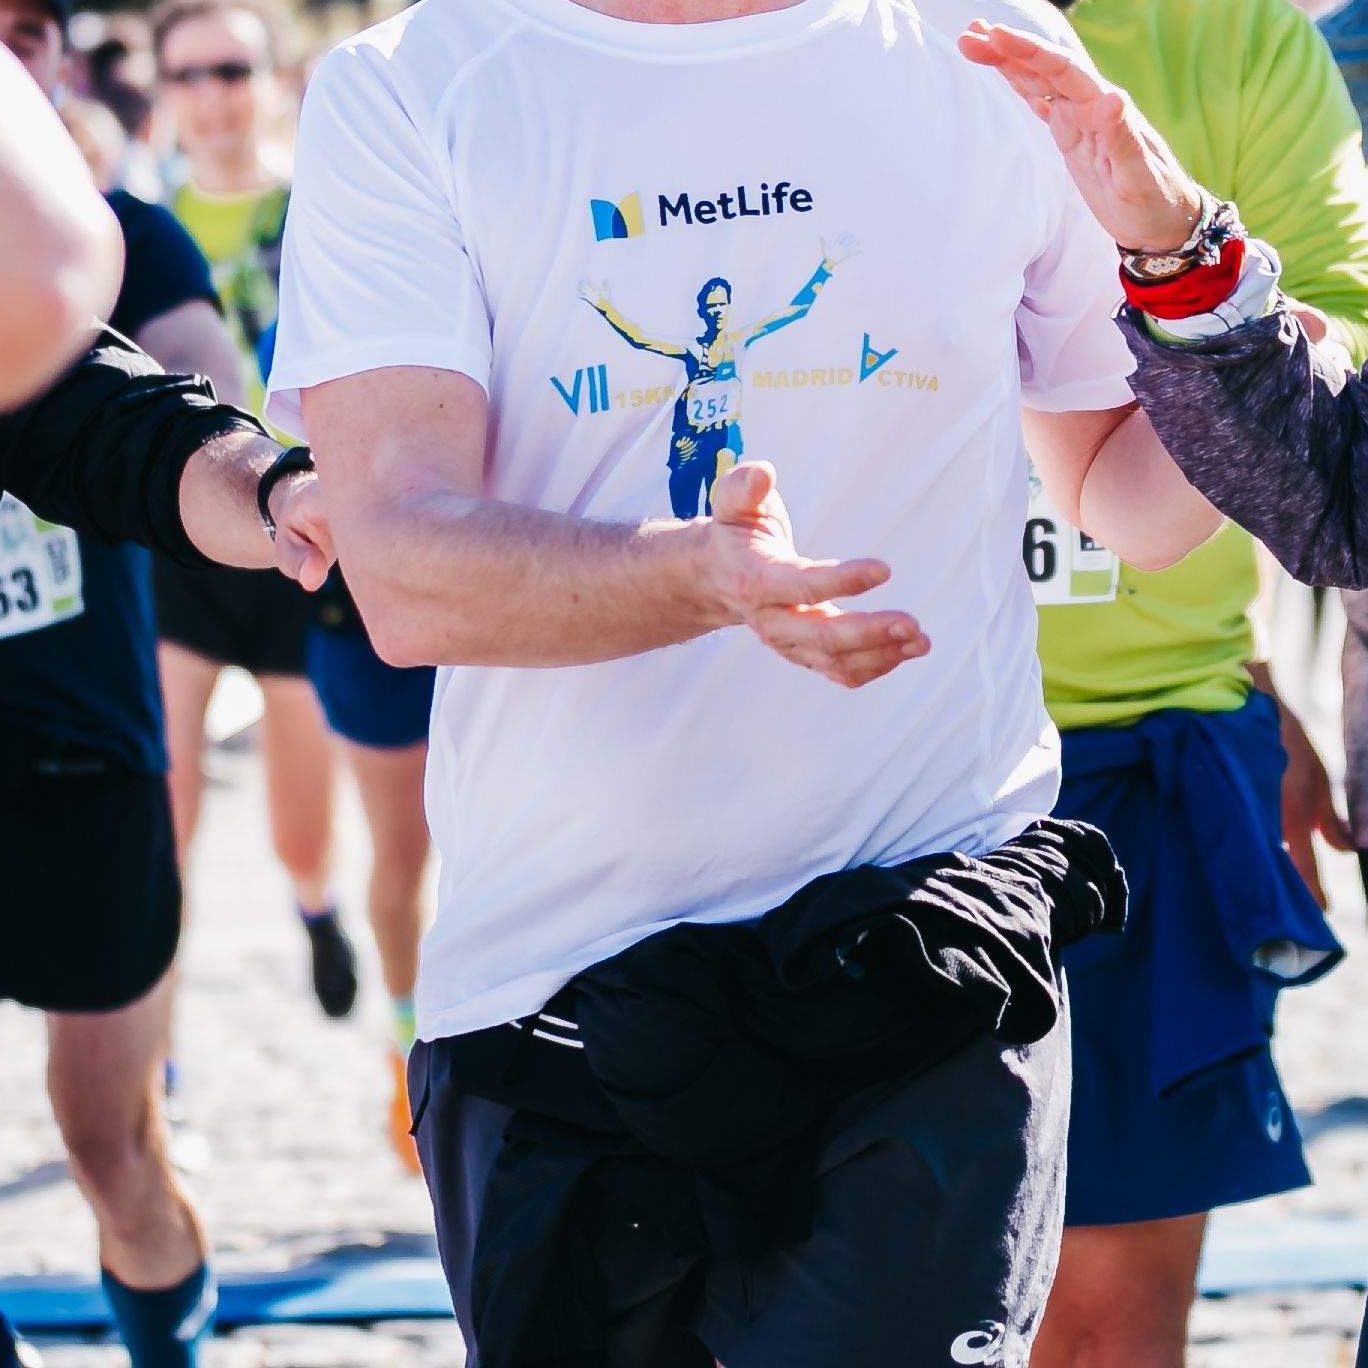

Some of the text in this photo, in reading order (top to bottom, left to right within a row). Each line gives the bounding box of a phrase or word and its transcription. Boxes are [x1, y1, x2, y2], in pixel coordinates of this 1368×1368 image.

[656, 181, 815, 227] MetLife
[549, 363, 610, 417] VII
[751, 366, 853, 389] MADRID
[692, 394, 729, 421] 252
